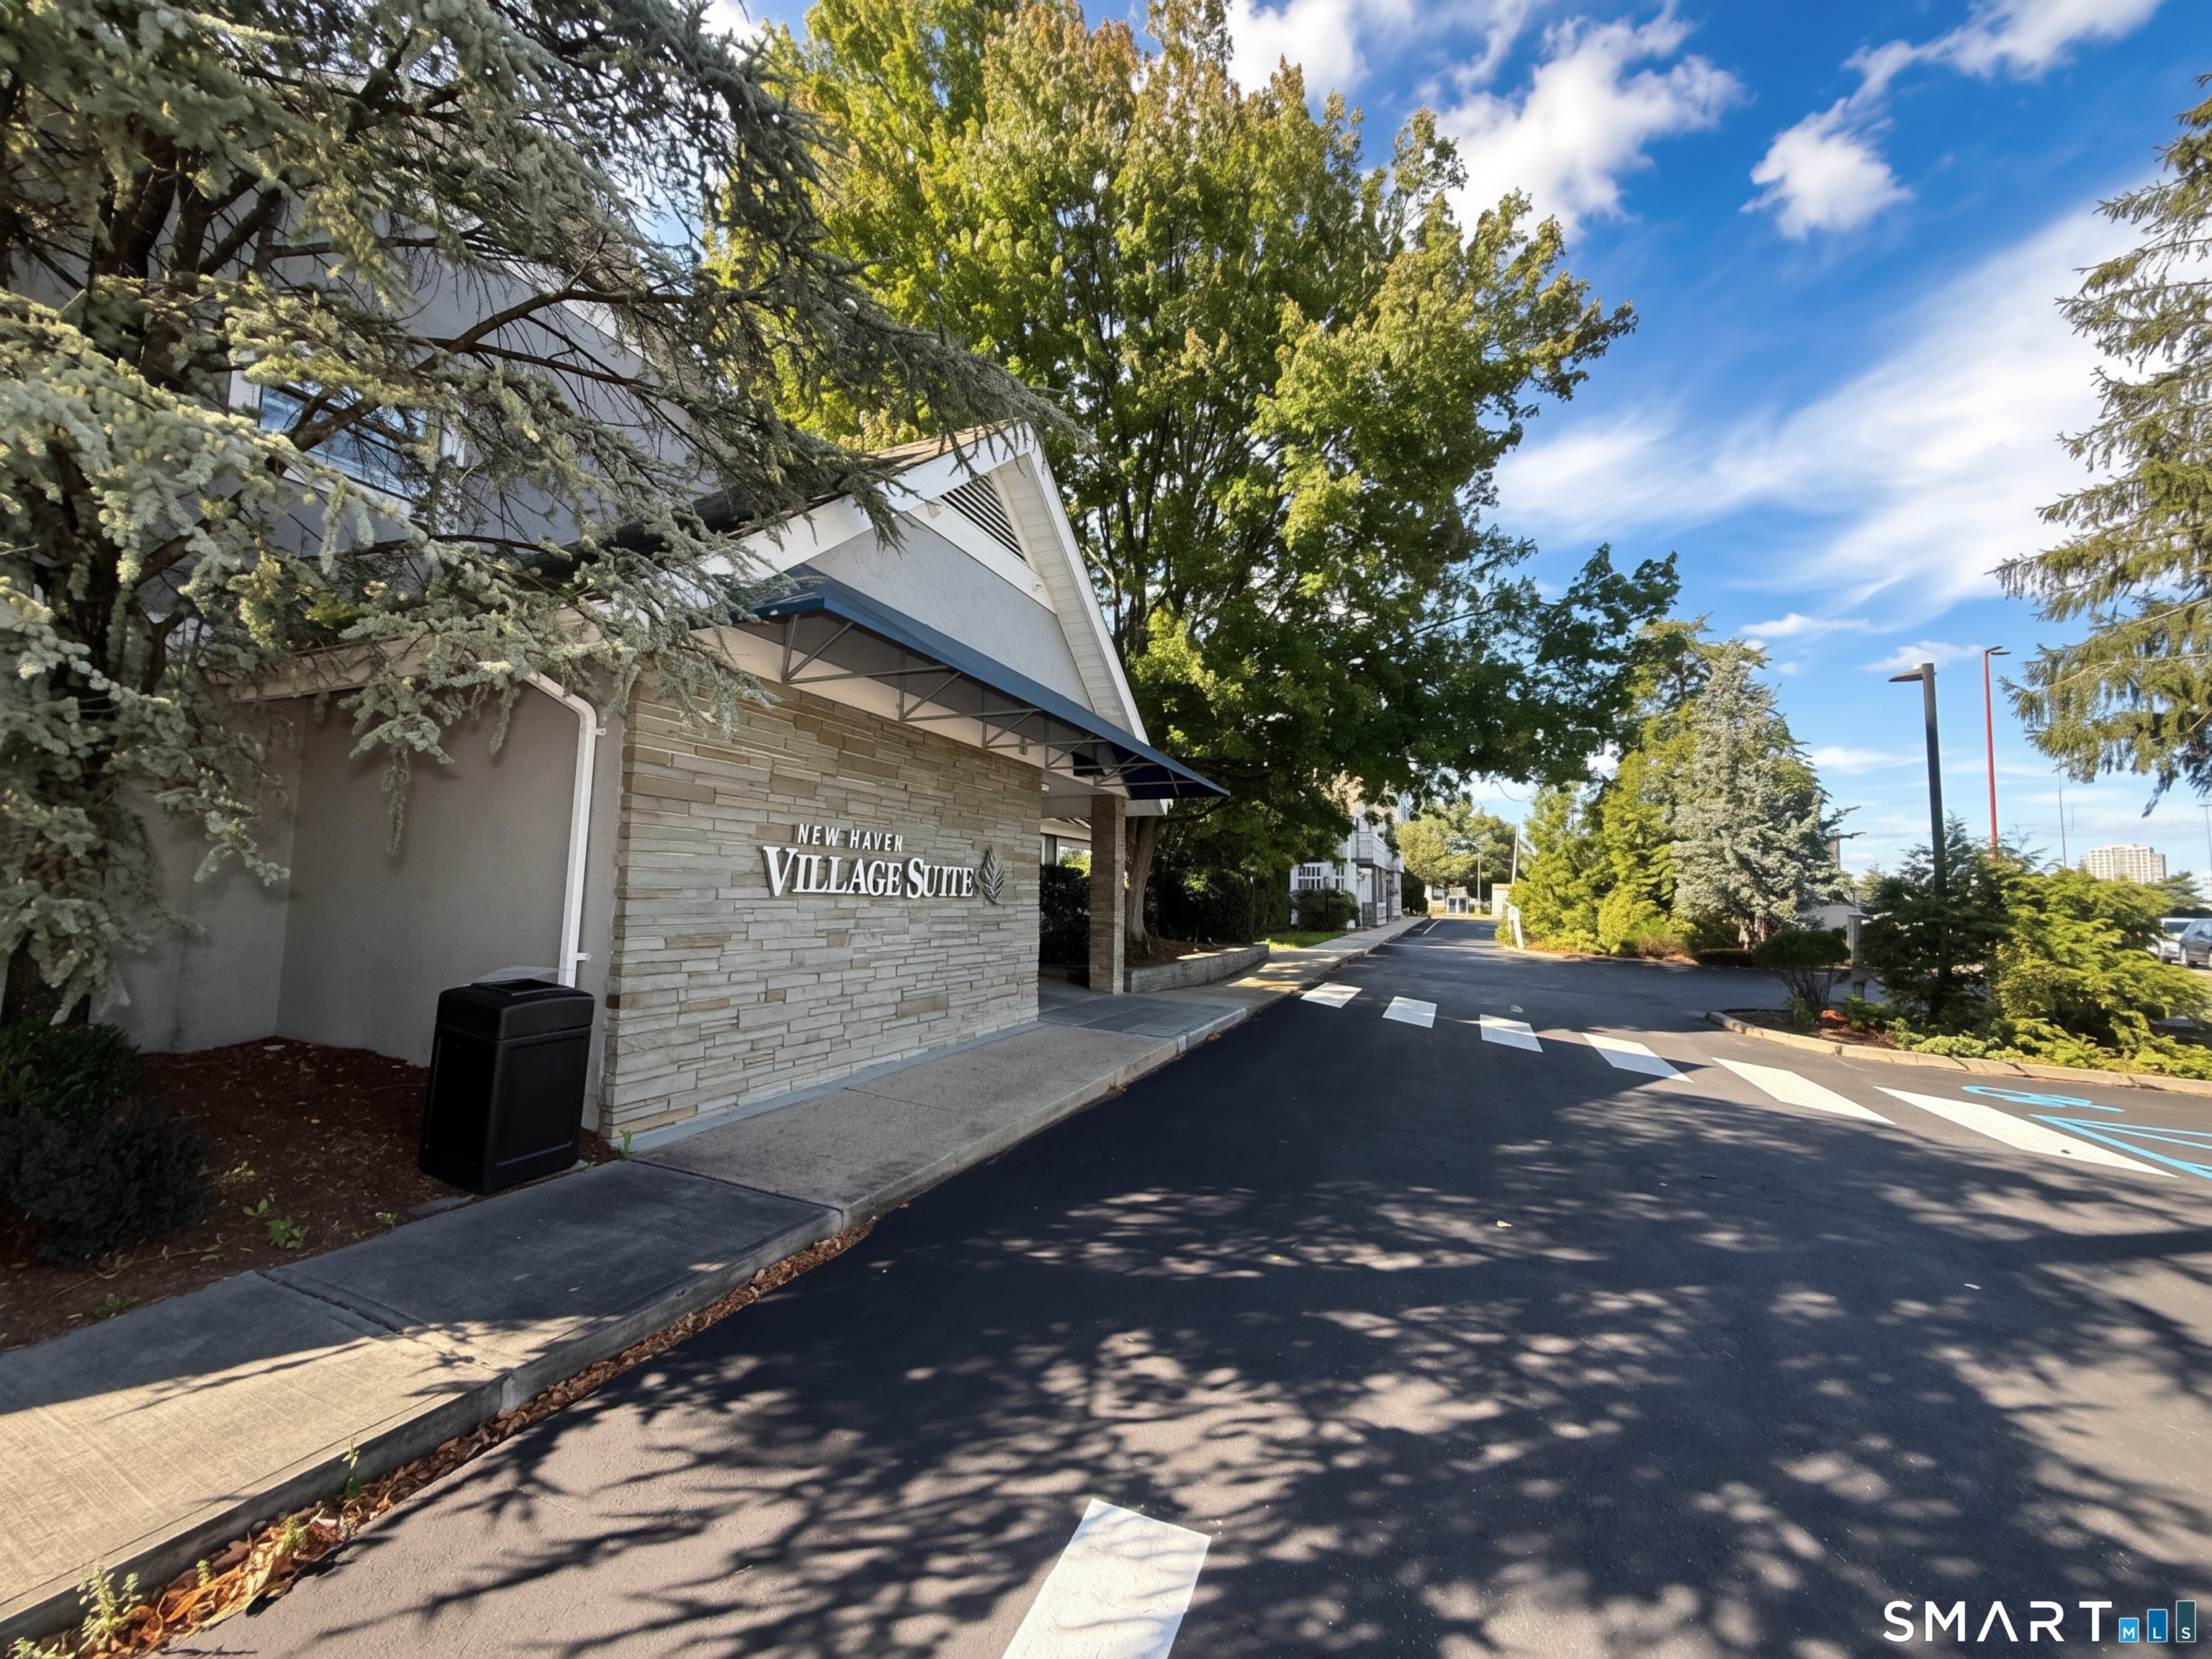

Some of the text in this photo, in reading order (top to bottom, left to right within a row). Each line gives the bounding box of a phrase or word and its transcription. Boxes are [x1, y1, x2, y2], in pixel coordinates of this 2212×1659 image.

[796, 823, 904, 853] NEW HAVEN
[763, 845, 974, 899] VILLAGE SUITE
